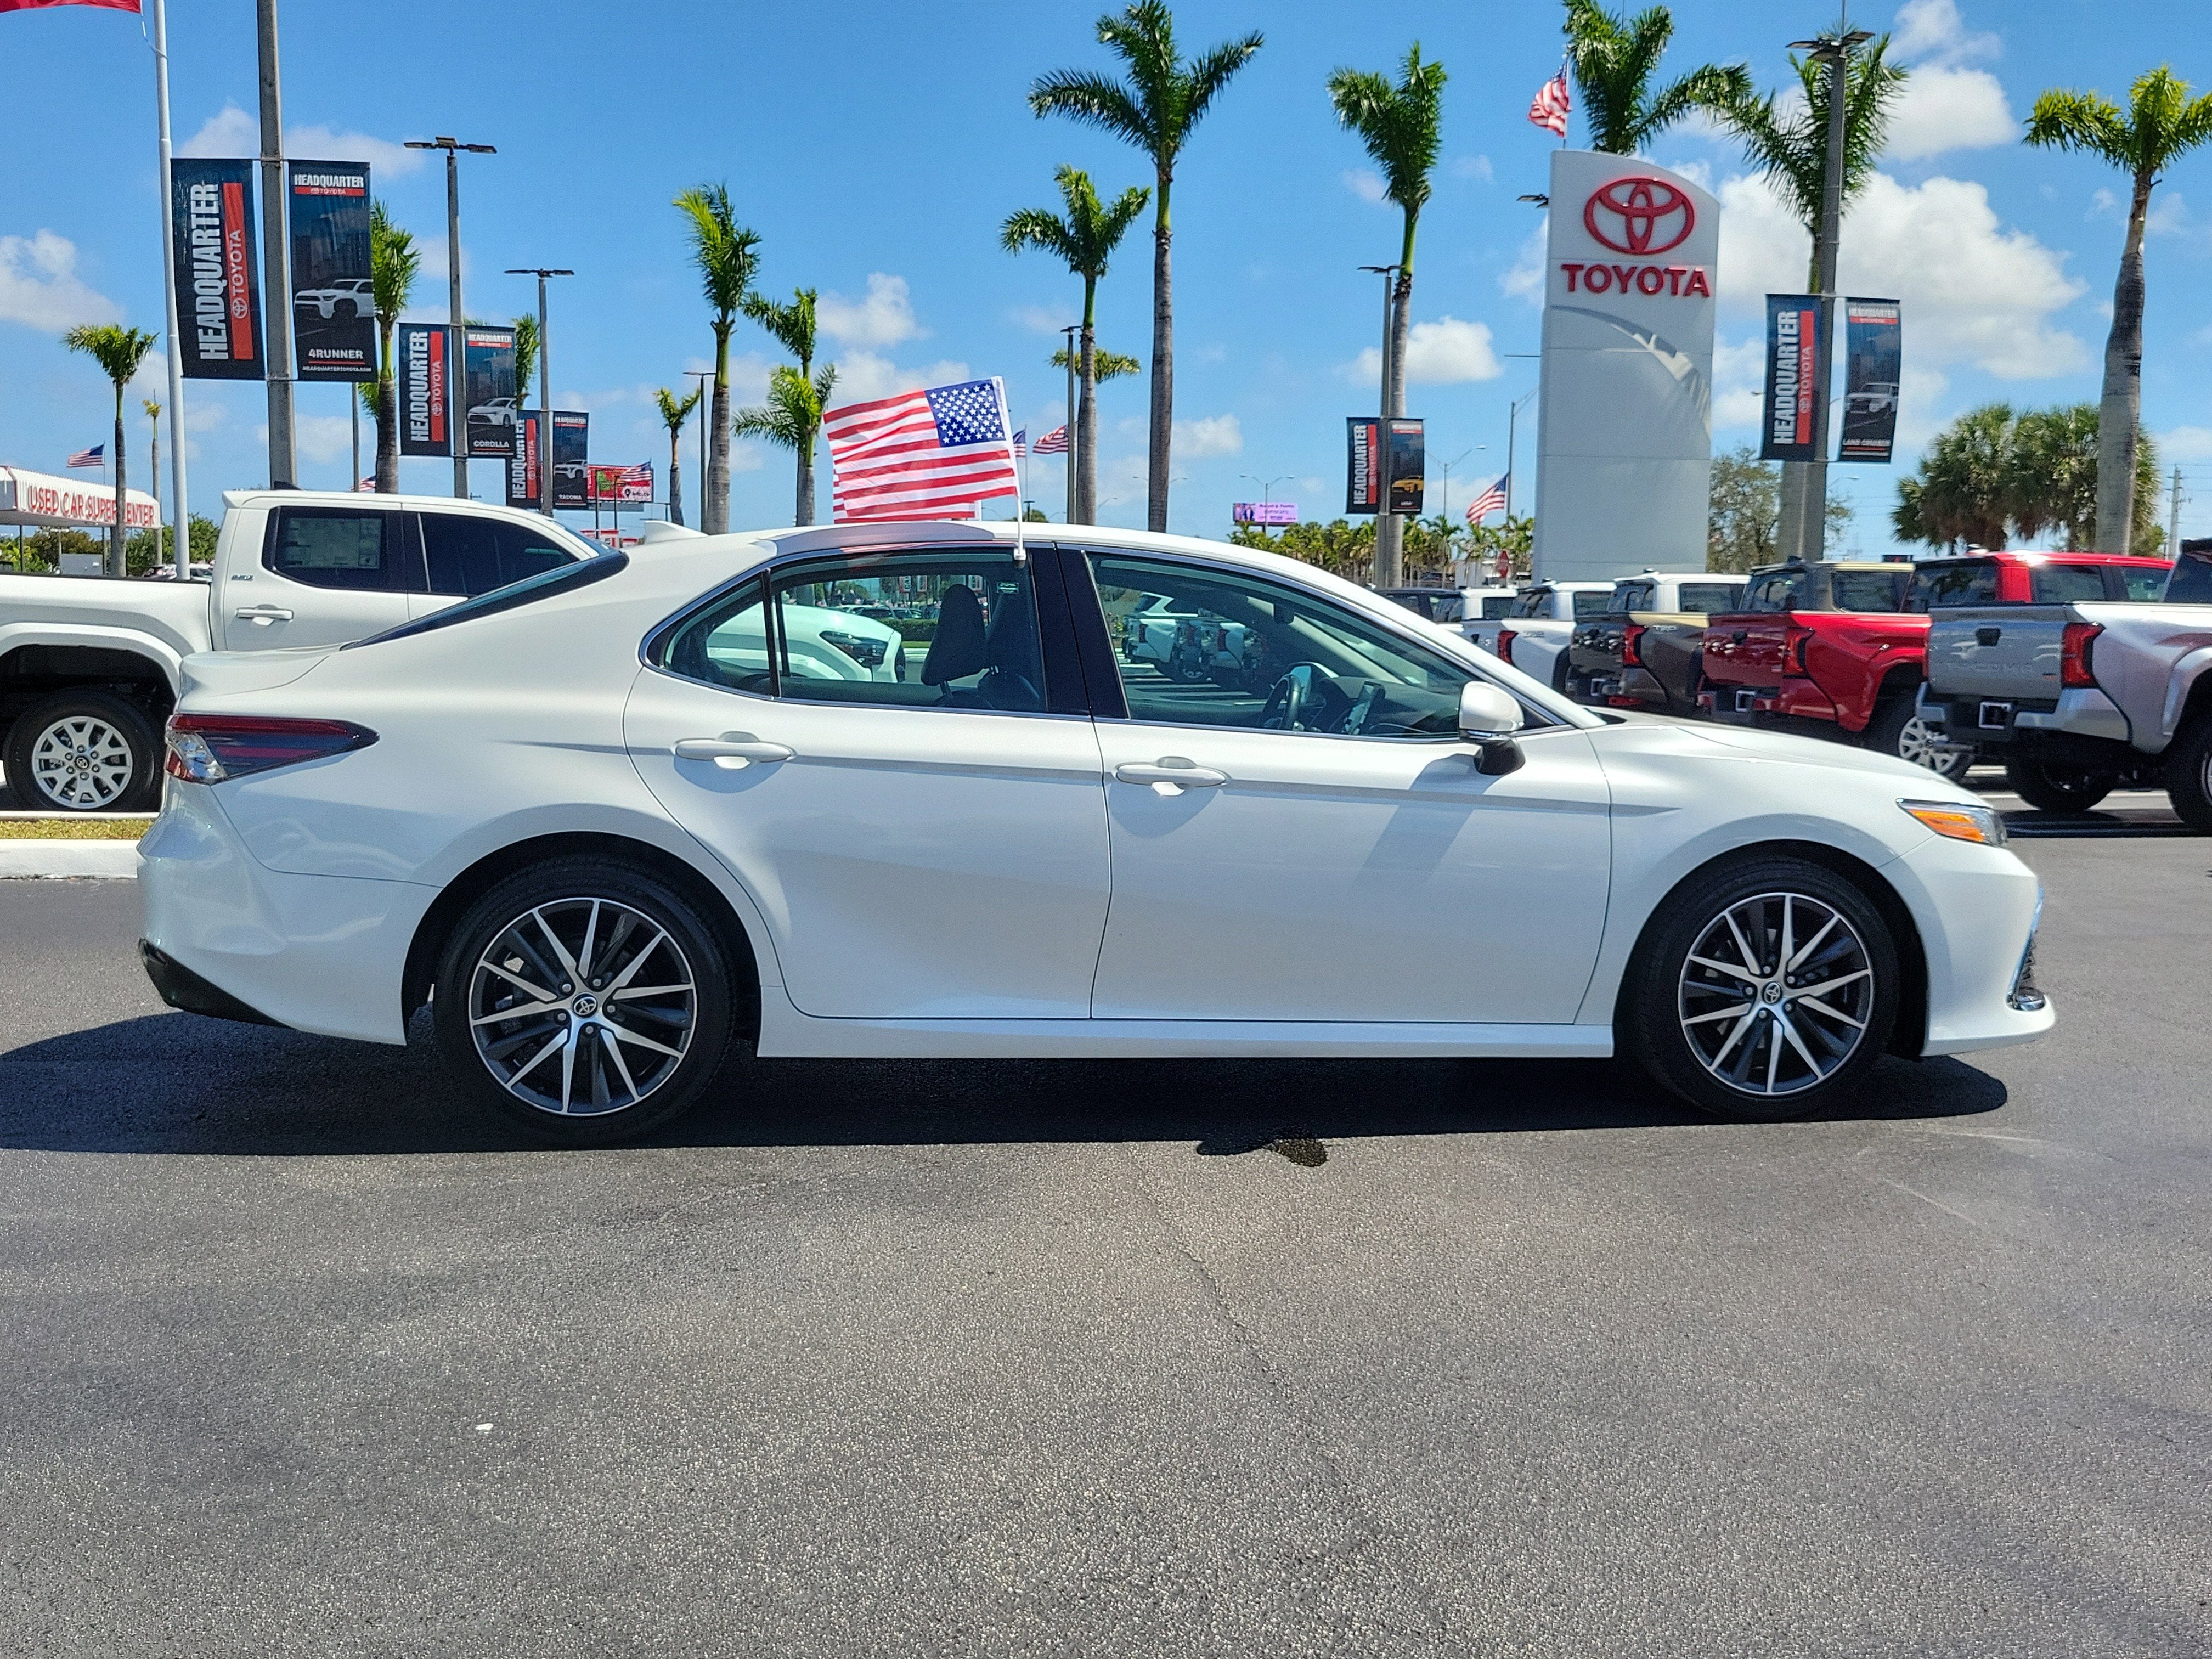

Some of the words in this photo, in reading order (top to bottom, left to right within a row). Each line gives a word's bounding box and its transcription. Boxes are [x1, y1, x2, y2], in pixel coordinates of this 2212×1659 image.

[295, 174, 364, 188] HEADQUARTER
[190, 183, 229, 360] HEADQUARTER
[229, 229, 245, 297] TOYOTA
[1561, 261, 1709, 298] TOYOTA
[308, 348, 364, 359] 4RUNNER
[1800, 346, 1812, 397] TOYOTA
[409, 331, 431, 442] HEADQUARTER
[432, 361, 441, 401] TOYOTA
[1773, 311, 1799, 444] HEADQUARTER
[473, 439, 510, 448] COROLLA
[1353, 425, 1369, 505] HEADQUARTER
[30, 486, 59, 511] USED
[63, 492, 84, 518] CAR
[87, 495, 117, 521] SUPER
[126, 503, 155, 525] ENTER
